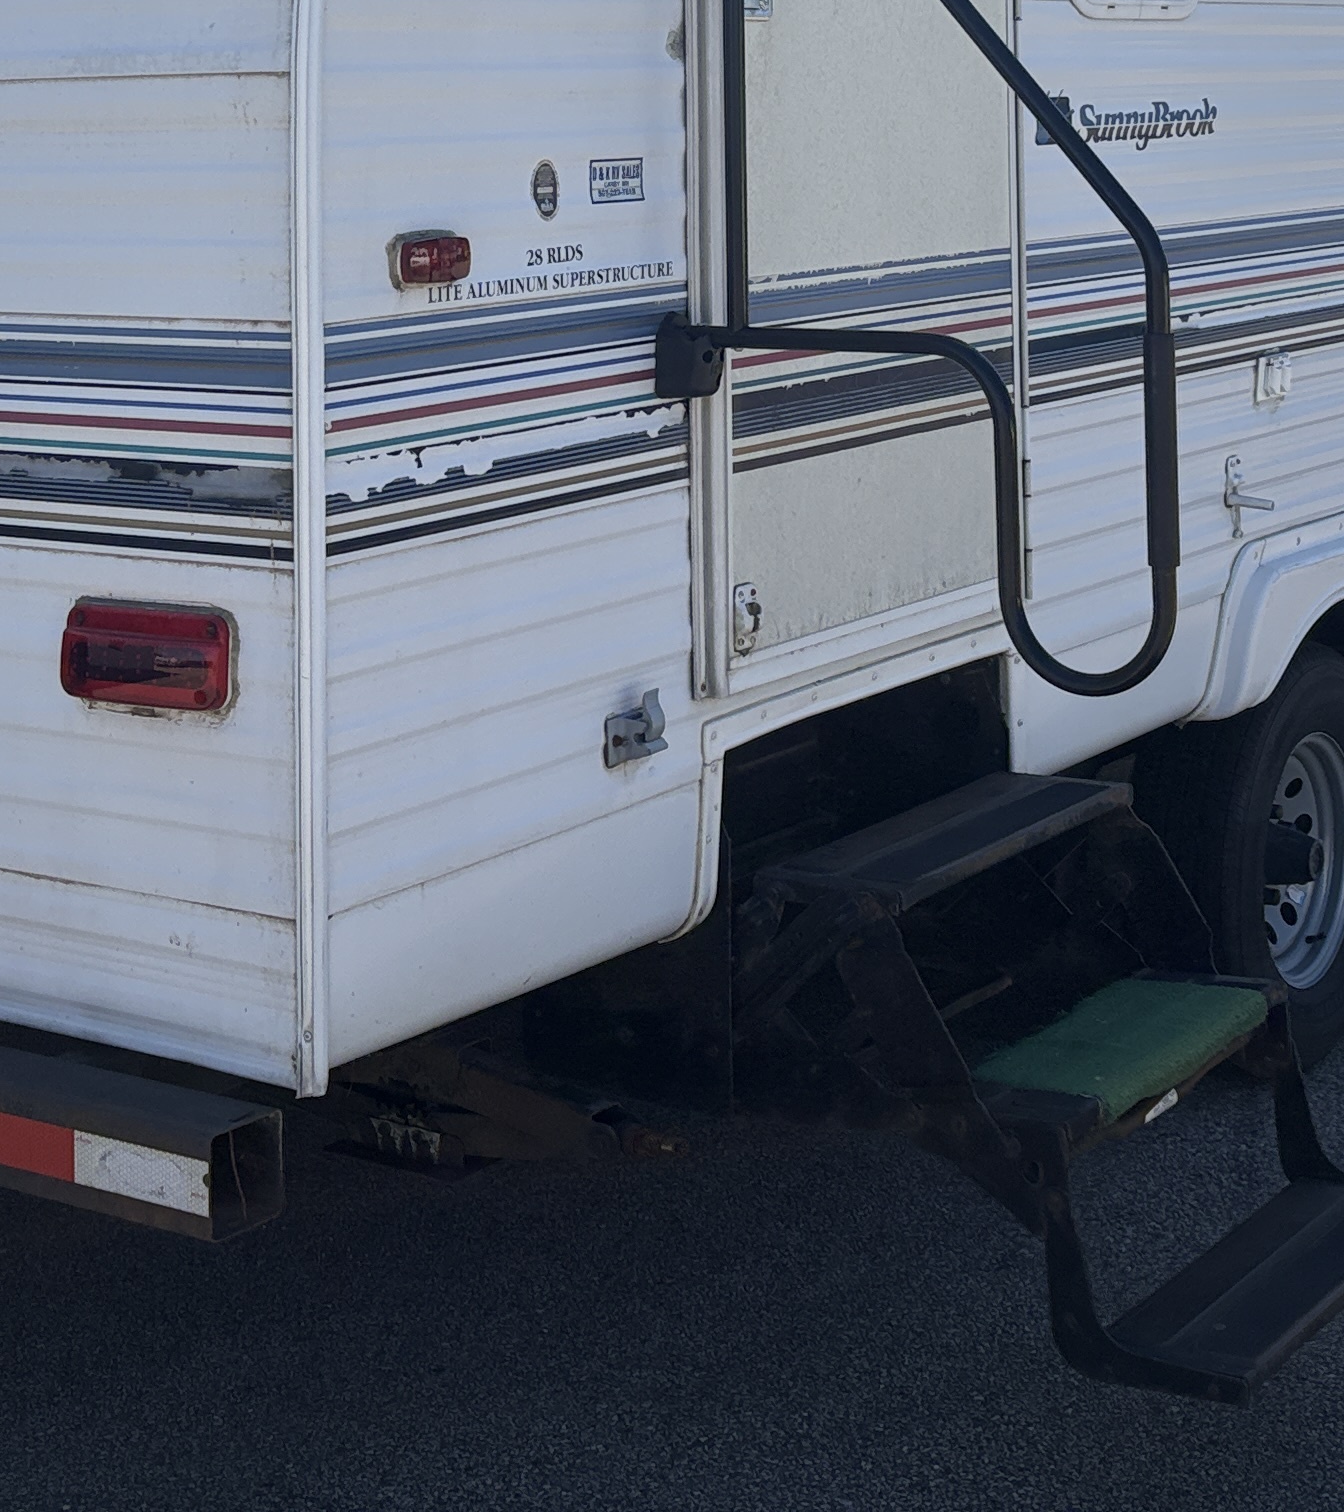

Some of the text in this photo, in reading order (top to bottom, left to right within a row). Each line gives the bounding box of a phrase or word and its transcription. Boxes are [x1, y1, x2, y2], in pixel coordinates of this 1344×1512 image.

[1077, 97, 1218, 151] SunnyBrook
[525, 244, 584, 267] 28 RLDS
[427, 260, 674, 304] LITE ALUMINUM SUPERSTRUCTURE
